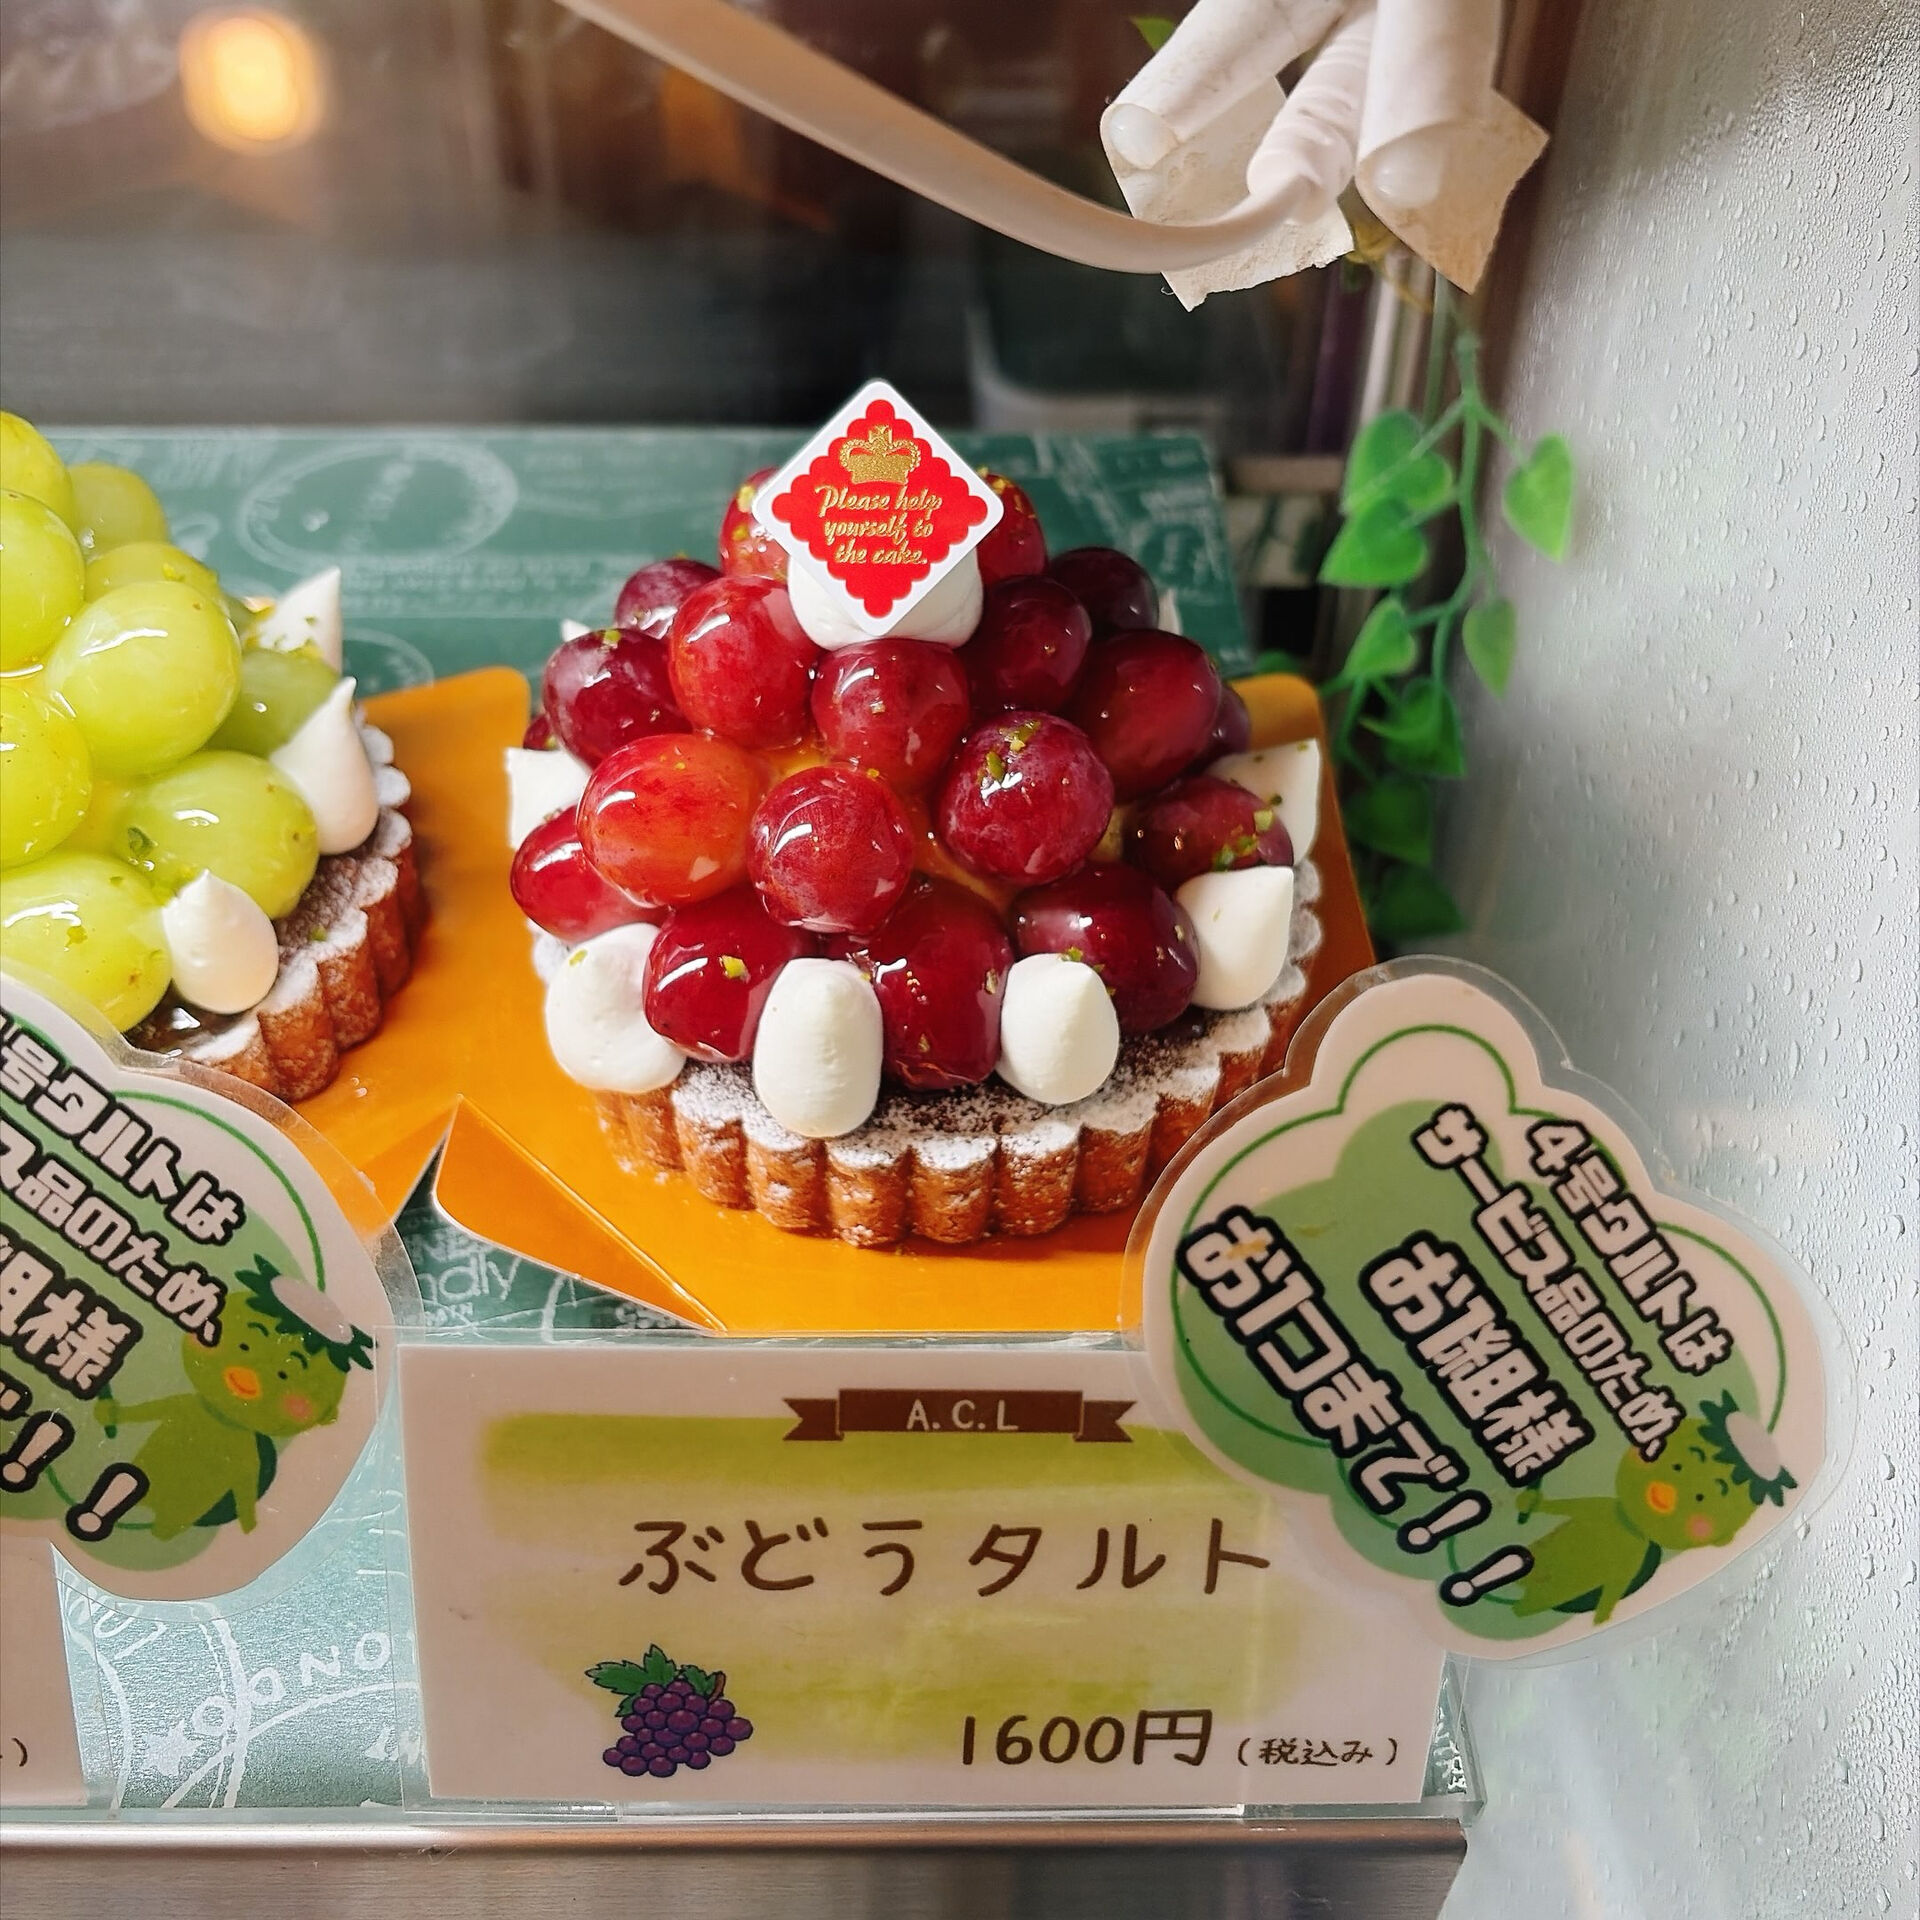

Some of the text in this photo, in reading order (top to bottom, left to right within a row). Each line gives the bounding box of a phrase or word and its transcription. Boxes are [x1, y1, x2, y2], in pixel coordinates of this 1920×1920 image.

[815, 484, 943, 520] Please help
[824, 512, 934, 546] yourself to
[834, 538, 928, 564] the cake.
[0, 1005, 247, 1246] 号タルトは
[1411, 1103, 1687, 1462] サービス品のため、
[1526, 1119, 1734, 1376] 4号タルトは
[1360, 1230, 1596, 1487] お1組様
[618, 1516, 1271, 1597] ぶどうタルト
[961, 1708, 1213, 1766] 1600円
